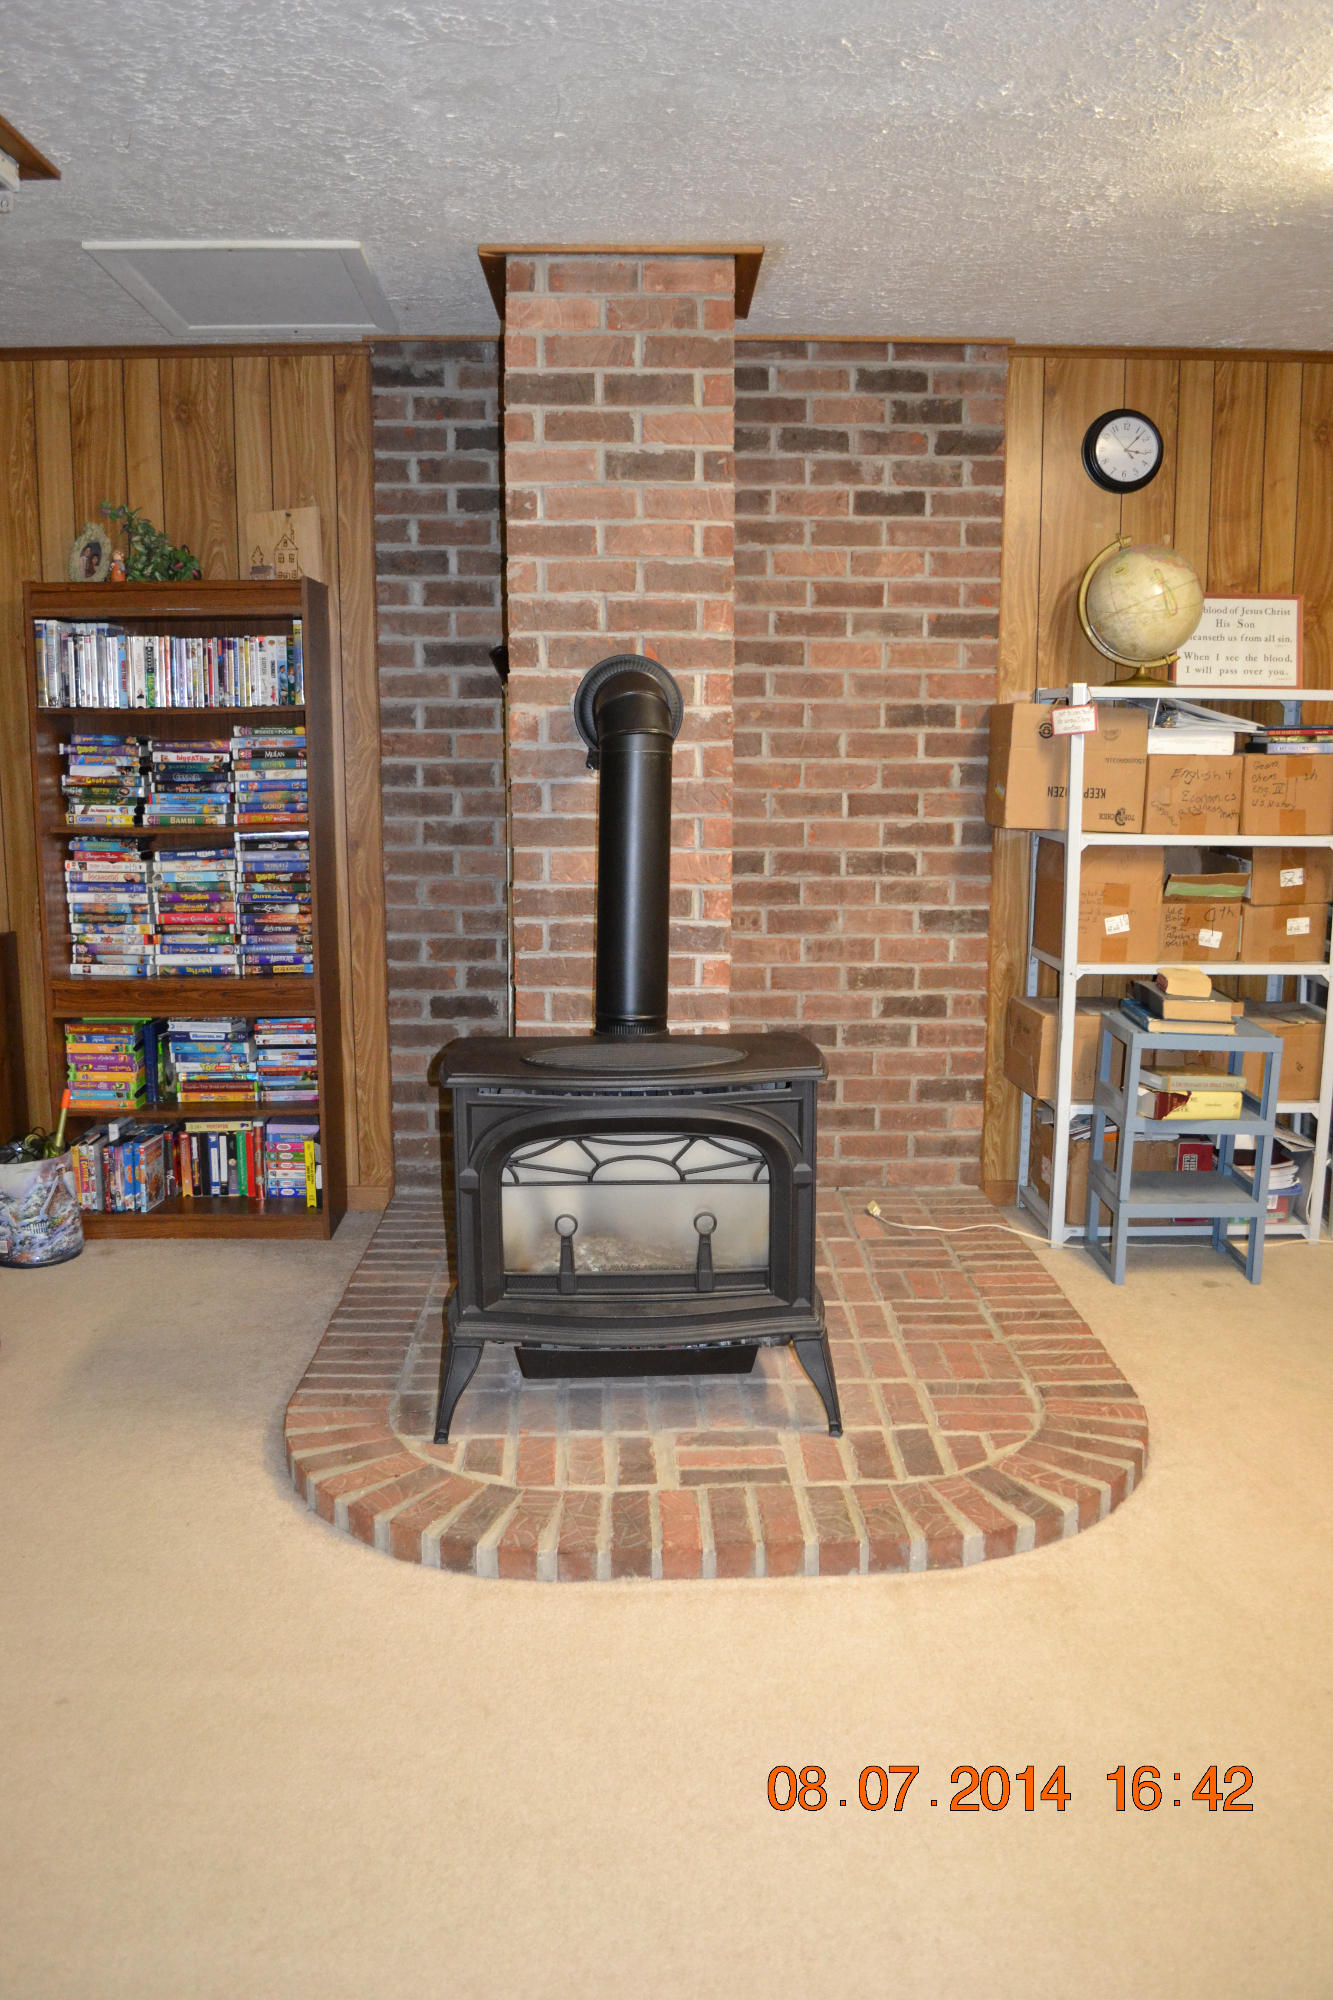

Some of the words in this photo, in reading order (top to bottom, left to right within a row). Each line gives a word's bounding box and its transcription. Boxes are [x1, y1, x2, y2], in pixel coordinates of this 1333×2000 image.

[1203, 606, 1229, 614] blood
[1229, 606, 1239, 614] of
[1240, 607, 1263, 617] Jesus
[1264, 607, 1291, 615] Christ
[1216, 619, 1231, 628] His
[1237, 619, 1255, 628] Son
[1184, 652, 1210, 661] When
[1245, 654, 1258, 662] the
[1195, 666, 1212, 674] will
[1220, 668, 1238, 677] pass
[1084, 788, 1106, 799] KEEP
